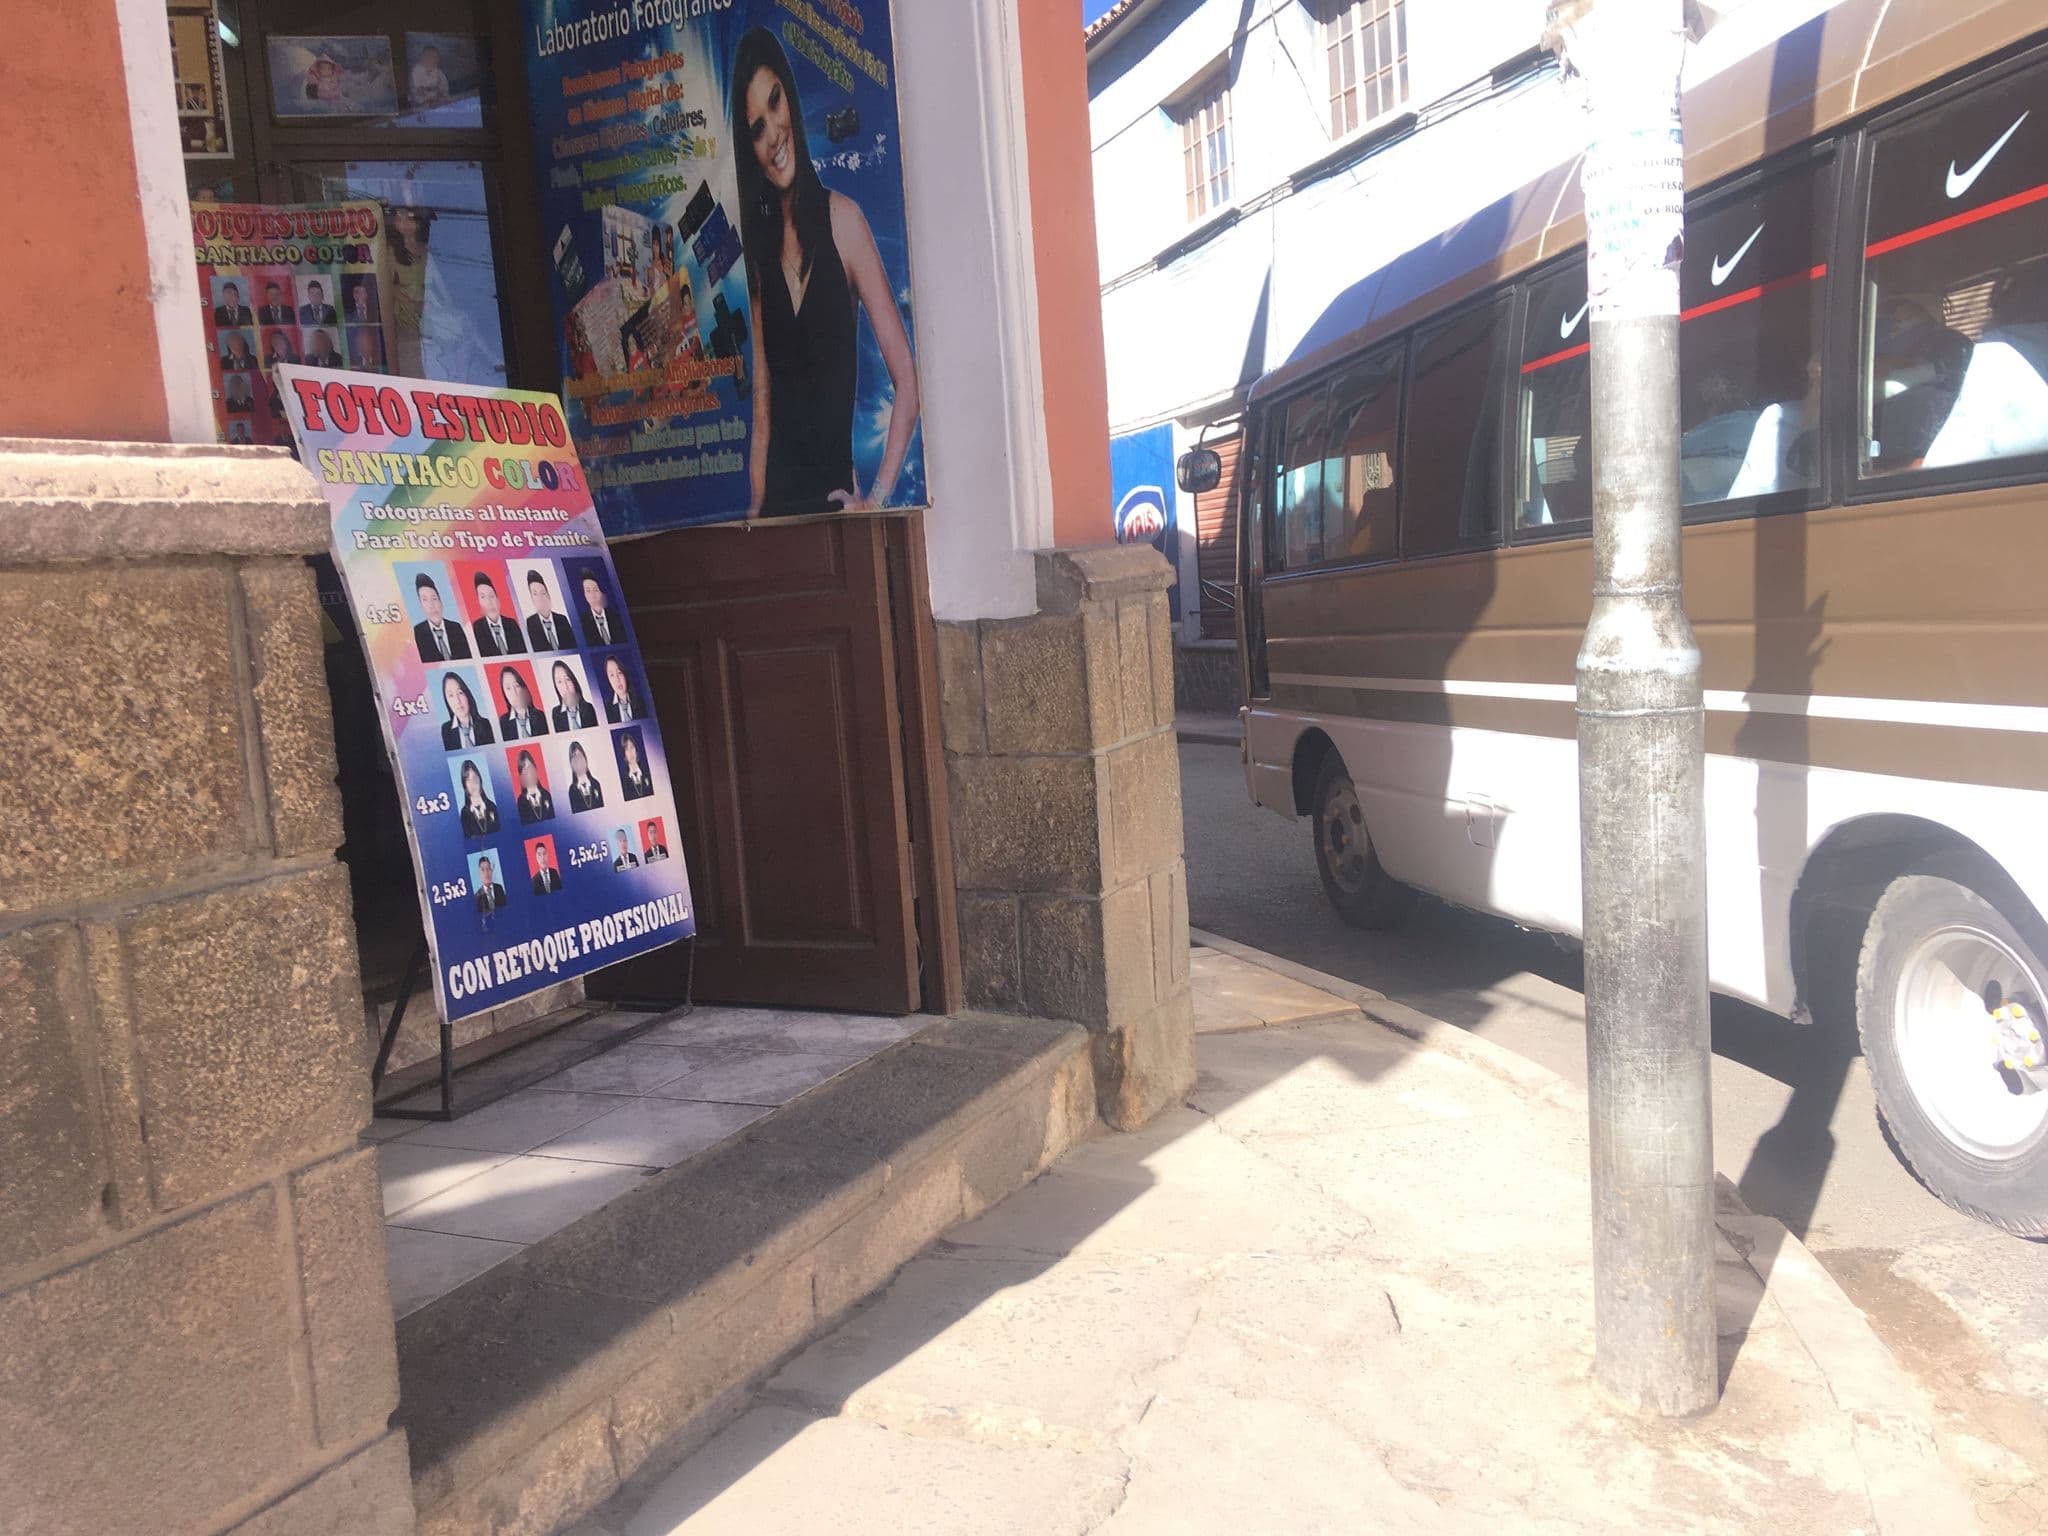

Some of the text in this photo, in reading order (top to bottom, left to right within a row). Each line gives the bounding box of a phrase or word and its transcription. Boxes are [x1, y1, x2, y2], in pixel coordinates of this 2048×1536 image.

[536, 2, 630, 57] Laboratorio
[653, 109, 706, 135] Celulares,
[191, 207, 378, 240] OTO ESTUDIO
[195, 243, 374, 266] SANTIAGO COLOR
[292, 378, 412, 437] FOTO
[411, 390, 567, 448] ESTUDIO
[318, 448, 482, 489] SANTIAGO
[483, 457, 580, 491] COLOR
[478, 504, 496, 521] al
[498, 504, 569, 522] Instante
[353, 530, 591, 552] Para Todo Tipo de Tramite
[365, 603, 403, 625] 4x5
[392, 693, 429, 717] 4x4
[416, 791, 451, 816] 4x3
[568, 840, 609, 869] 2,5x2,5
[431, 877, 468, 907] 2,5x3
[448, 891, 689, 1000] CON RETOQUE PROFESIONAL
